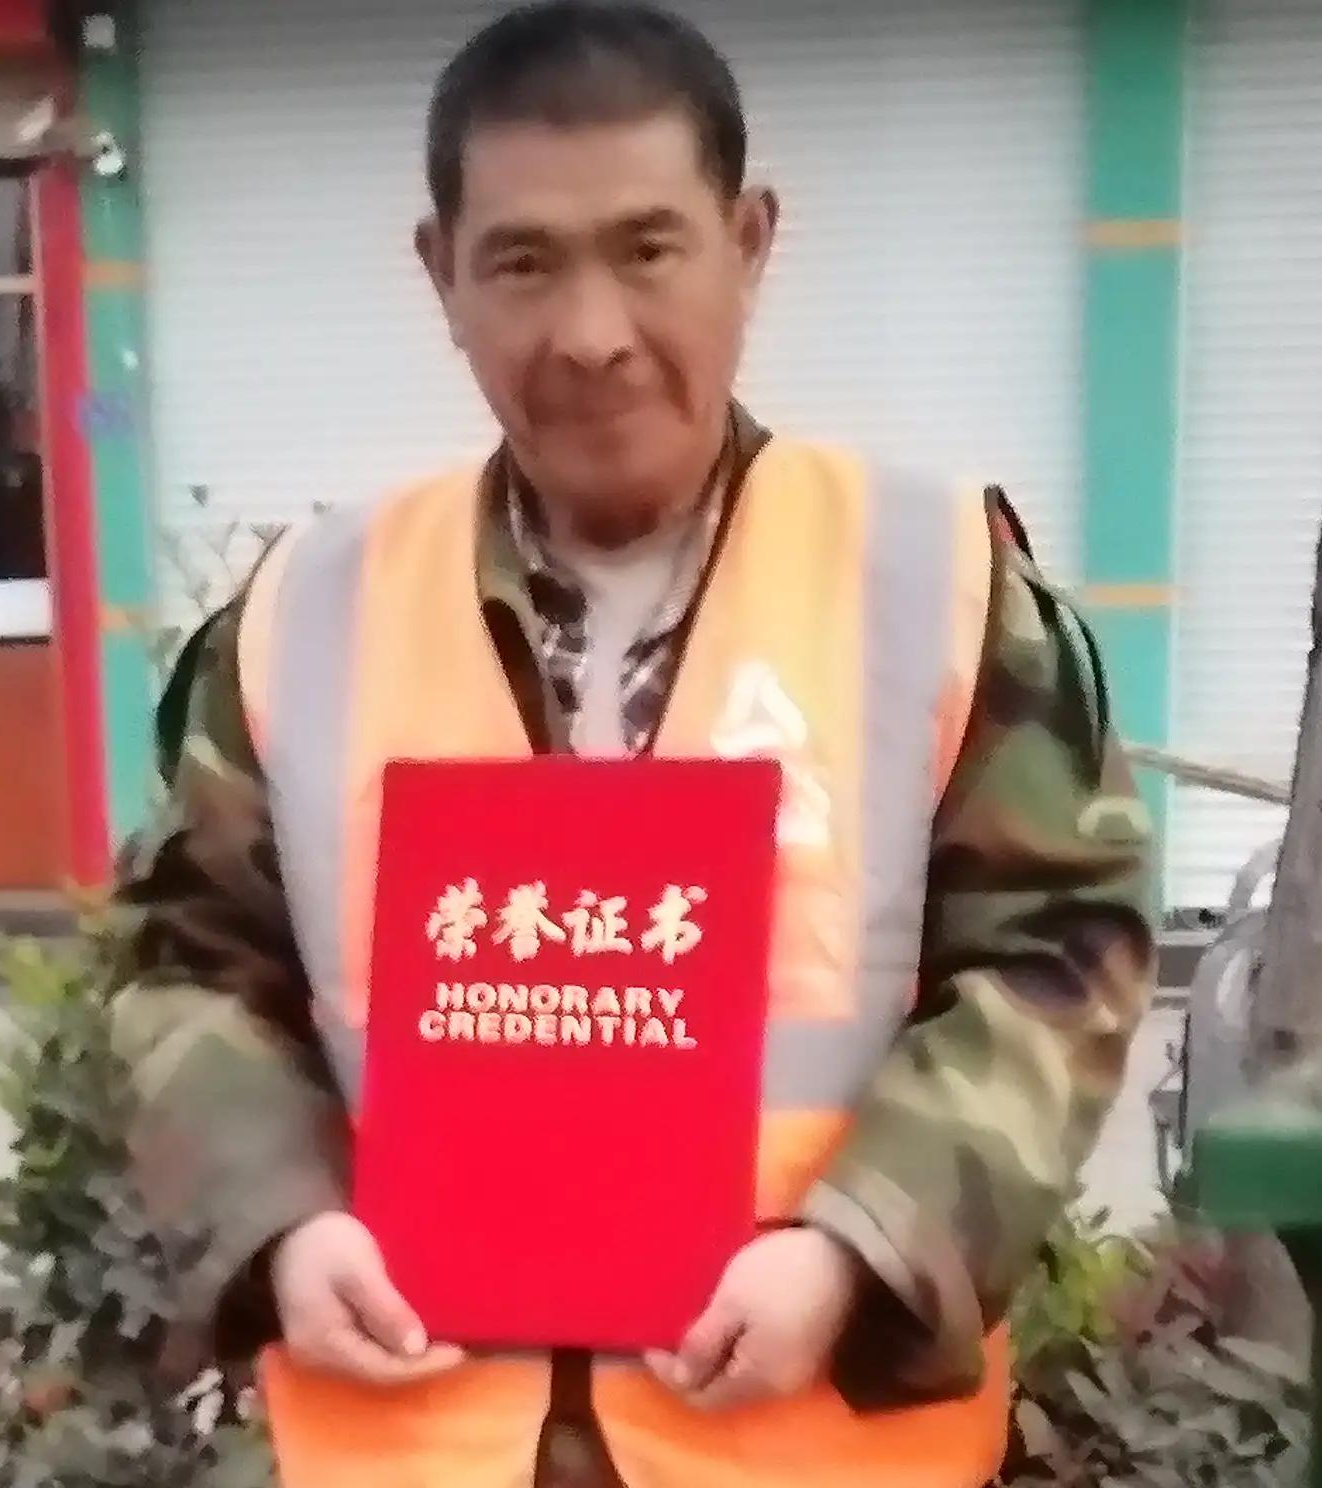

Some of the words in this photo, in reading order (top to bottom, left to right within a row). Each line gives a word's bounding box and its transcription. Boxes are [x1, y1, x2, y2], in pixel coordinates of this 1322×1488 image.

[424, 876, 708, 964] 荣誉证书
[435, 981, 685, 1018] HONORARY
[417, 1009, 699, 1049] CREDENTIAL
